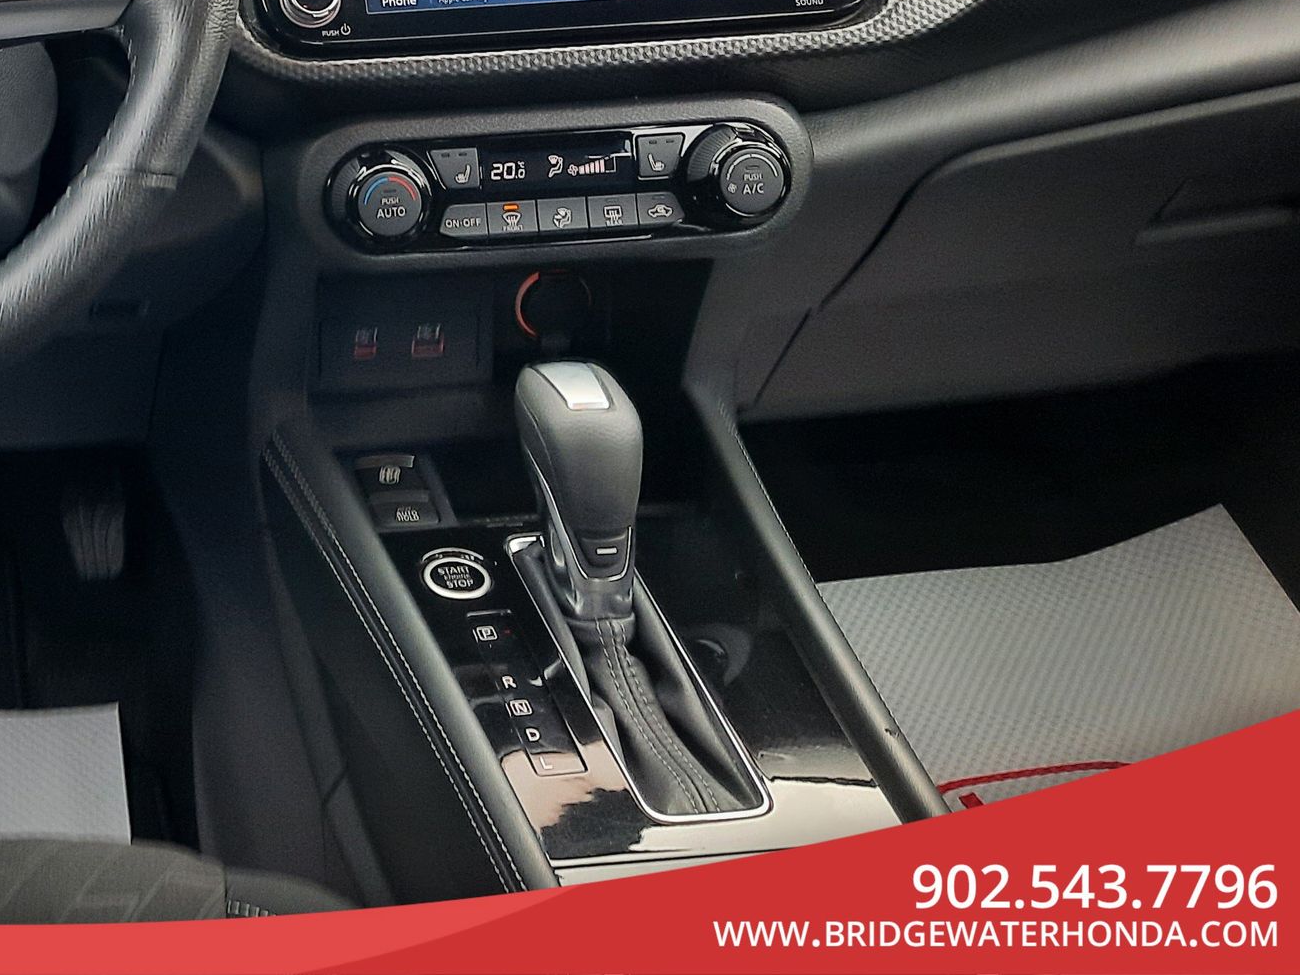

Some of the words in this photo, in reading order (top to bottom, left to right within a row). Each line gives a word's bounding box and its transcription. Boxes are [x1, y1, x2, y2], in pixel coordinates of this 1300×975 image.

[321, 29, 340, 37] PUSH
[490, 162, 525, 180] 20.0
[743, 173, 762, 182] PUSH
[742, 182, 764, 194] A/C
[381, 197, 399, 205] PUSH
[376, 207, 406, 219] AUTO
[437, 566, 470, 575] START
[446, 579, 474, 588] STOP
[502, 676, 517, 690] R
[526, 728, 541, 742] D
